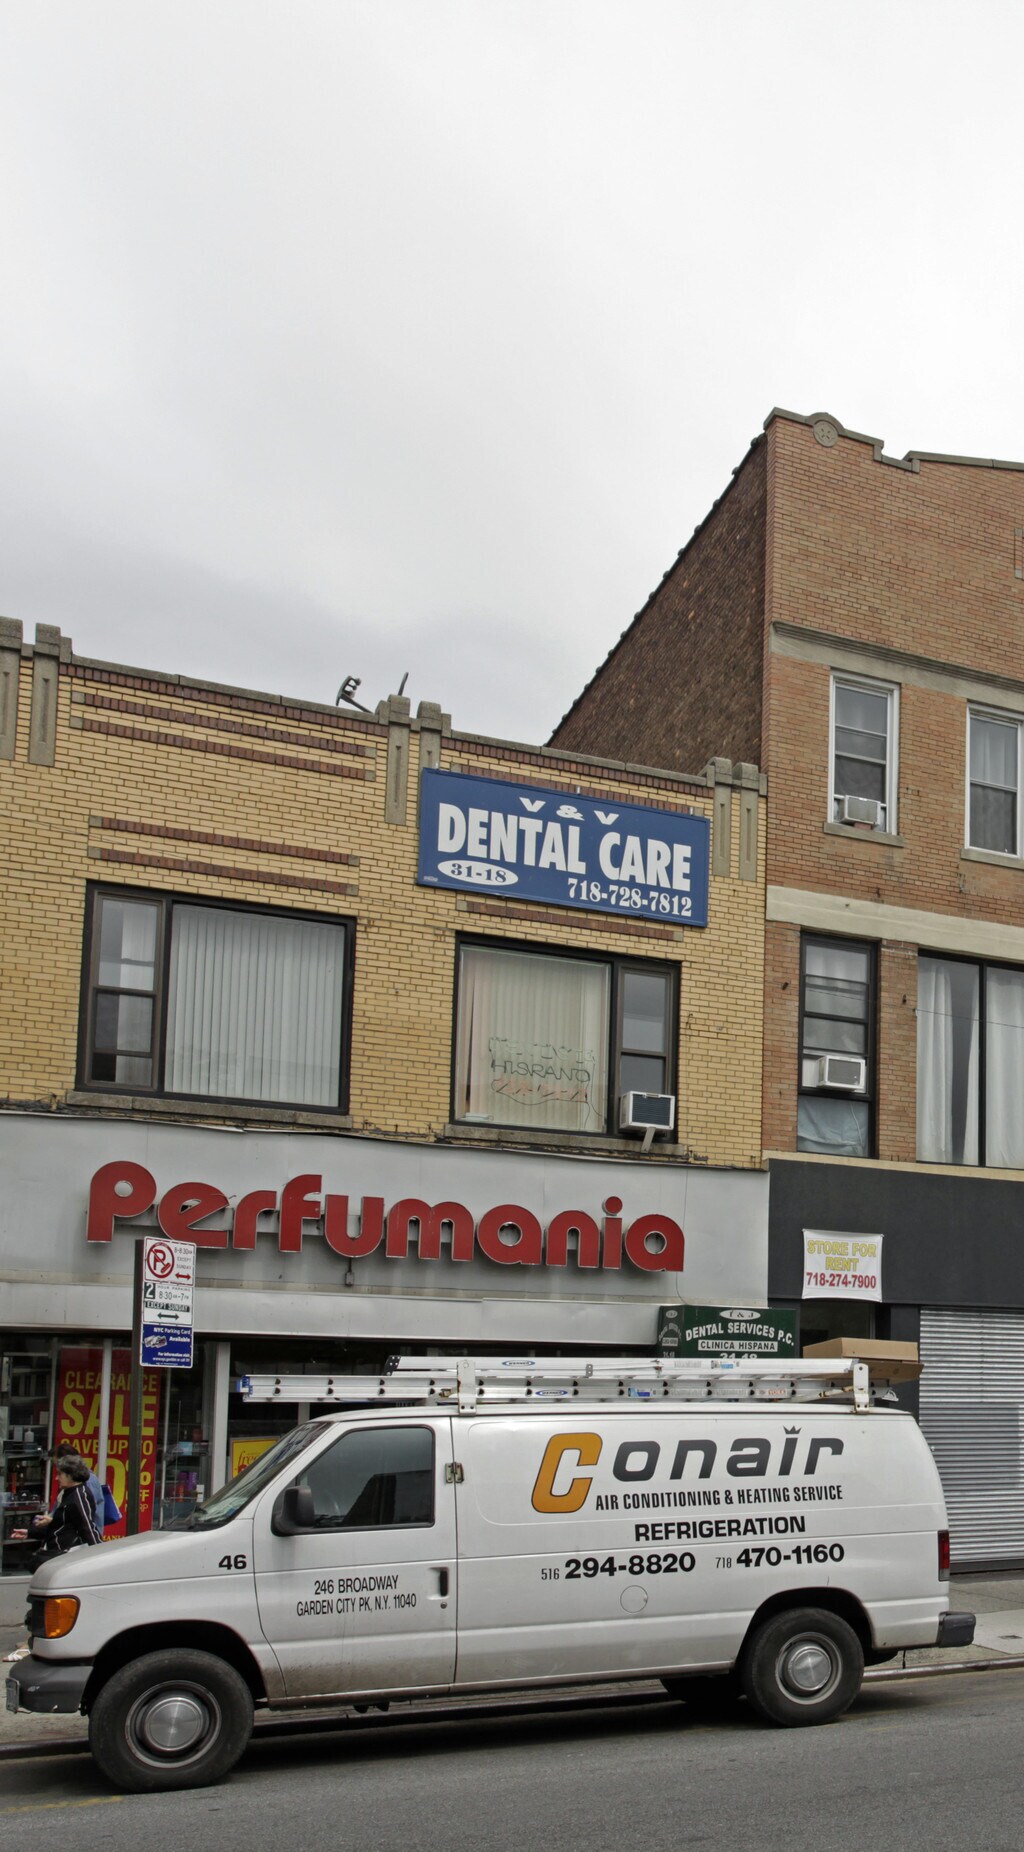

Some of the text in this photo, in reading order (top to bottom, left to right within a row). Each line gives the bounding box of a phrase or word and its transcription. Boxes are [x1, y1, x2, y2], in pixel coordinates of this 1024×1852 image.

[519, 797, 620, 825] V & V
[437, 802, 692, 892] DENTAL CARE
[449, 861, 508, 884] 31-18
[567, 878, 693, 917] 718-728-7812
[86, 1159, 686, 1273] Perfumania
[806, 1239, 877, 1258] STORE FOR
[825, 1256, 859, 1272] RENT
[145, 1282, 154, 1299] 2
[806, 1271, 877, 1289] 718-274-7900
[685, 1322, 724, 1341] DENTAL
[727, 1322, 775, 1338] SERVICES
[777, 1330, 795, 1346] P.C.
[700, 1341, 775, 1351] CLINICA HISPANA
[61, 1391, 157, 1436] SALE
[107, 1439, 128, 1454] UP
[531, 1426, 845, 1514] Conair
[595, 1485, 843, 1511] AIR CONDITIONING & HEATING SERVICE
[634, 1515, 806, 1542] REFRIGERATION
[218, 1554, 247, 1570] 46
[541, 1543, 845, 1581] 516 294-8820 718 470-1160
[314, 1575, 399, 1595] 246 BROADWAY
[296, 1593, 417, 1617] GARDEN CITY PK, N.Y. 11040
